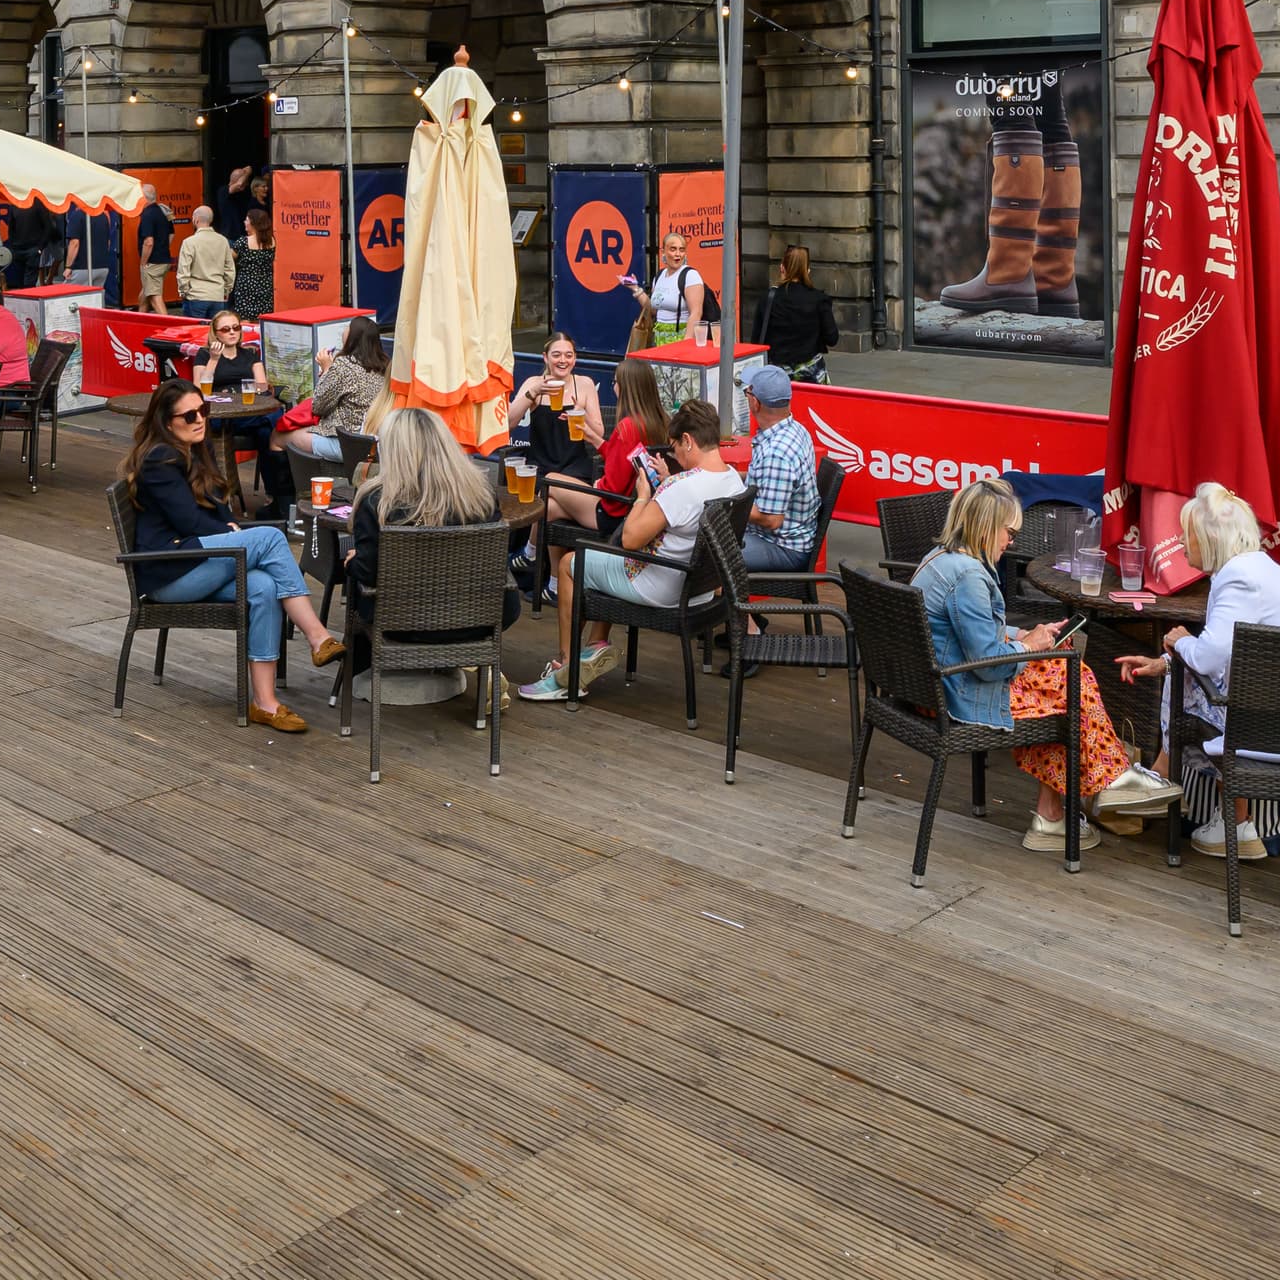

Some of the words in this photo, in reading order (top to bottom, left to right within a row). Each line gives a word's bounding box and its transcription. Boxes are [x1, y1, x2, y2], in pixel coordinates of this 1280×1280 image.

[955, 72, 1041, 101] dubarry
[955, 106, 1005, 118] COMING
[1009, 106, 1044, 116] SOON
[302, 199, 331, 209] events
[280, 210, 331, 230] together
[574, 228, 625, 266] AR
[290, 272, 325, 283] ASSEMBLY
[294, 282, 320, 292] ROOMS
[975, 328, 1042, 342] dubarry.com
